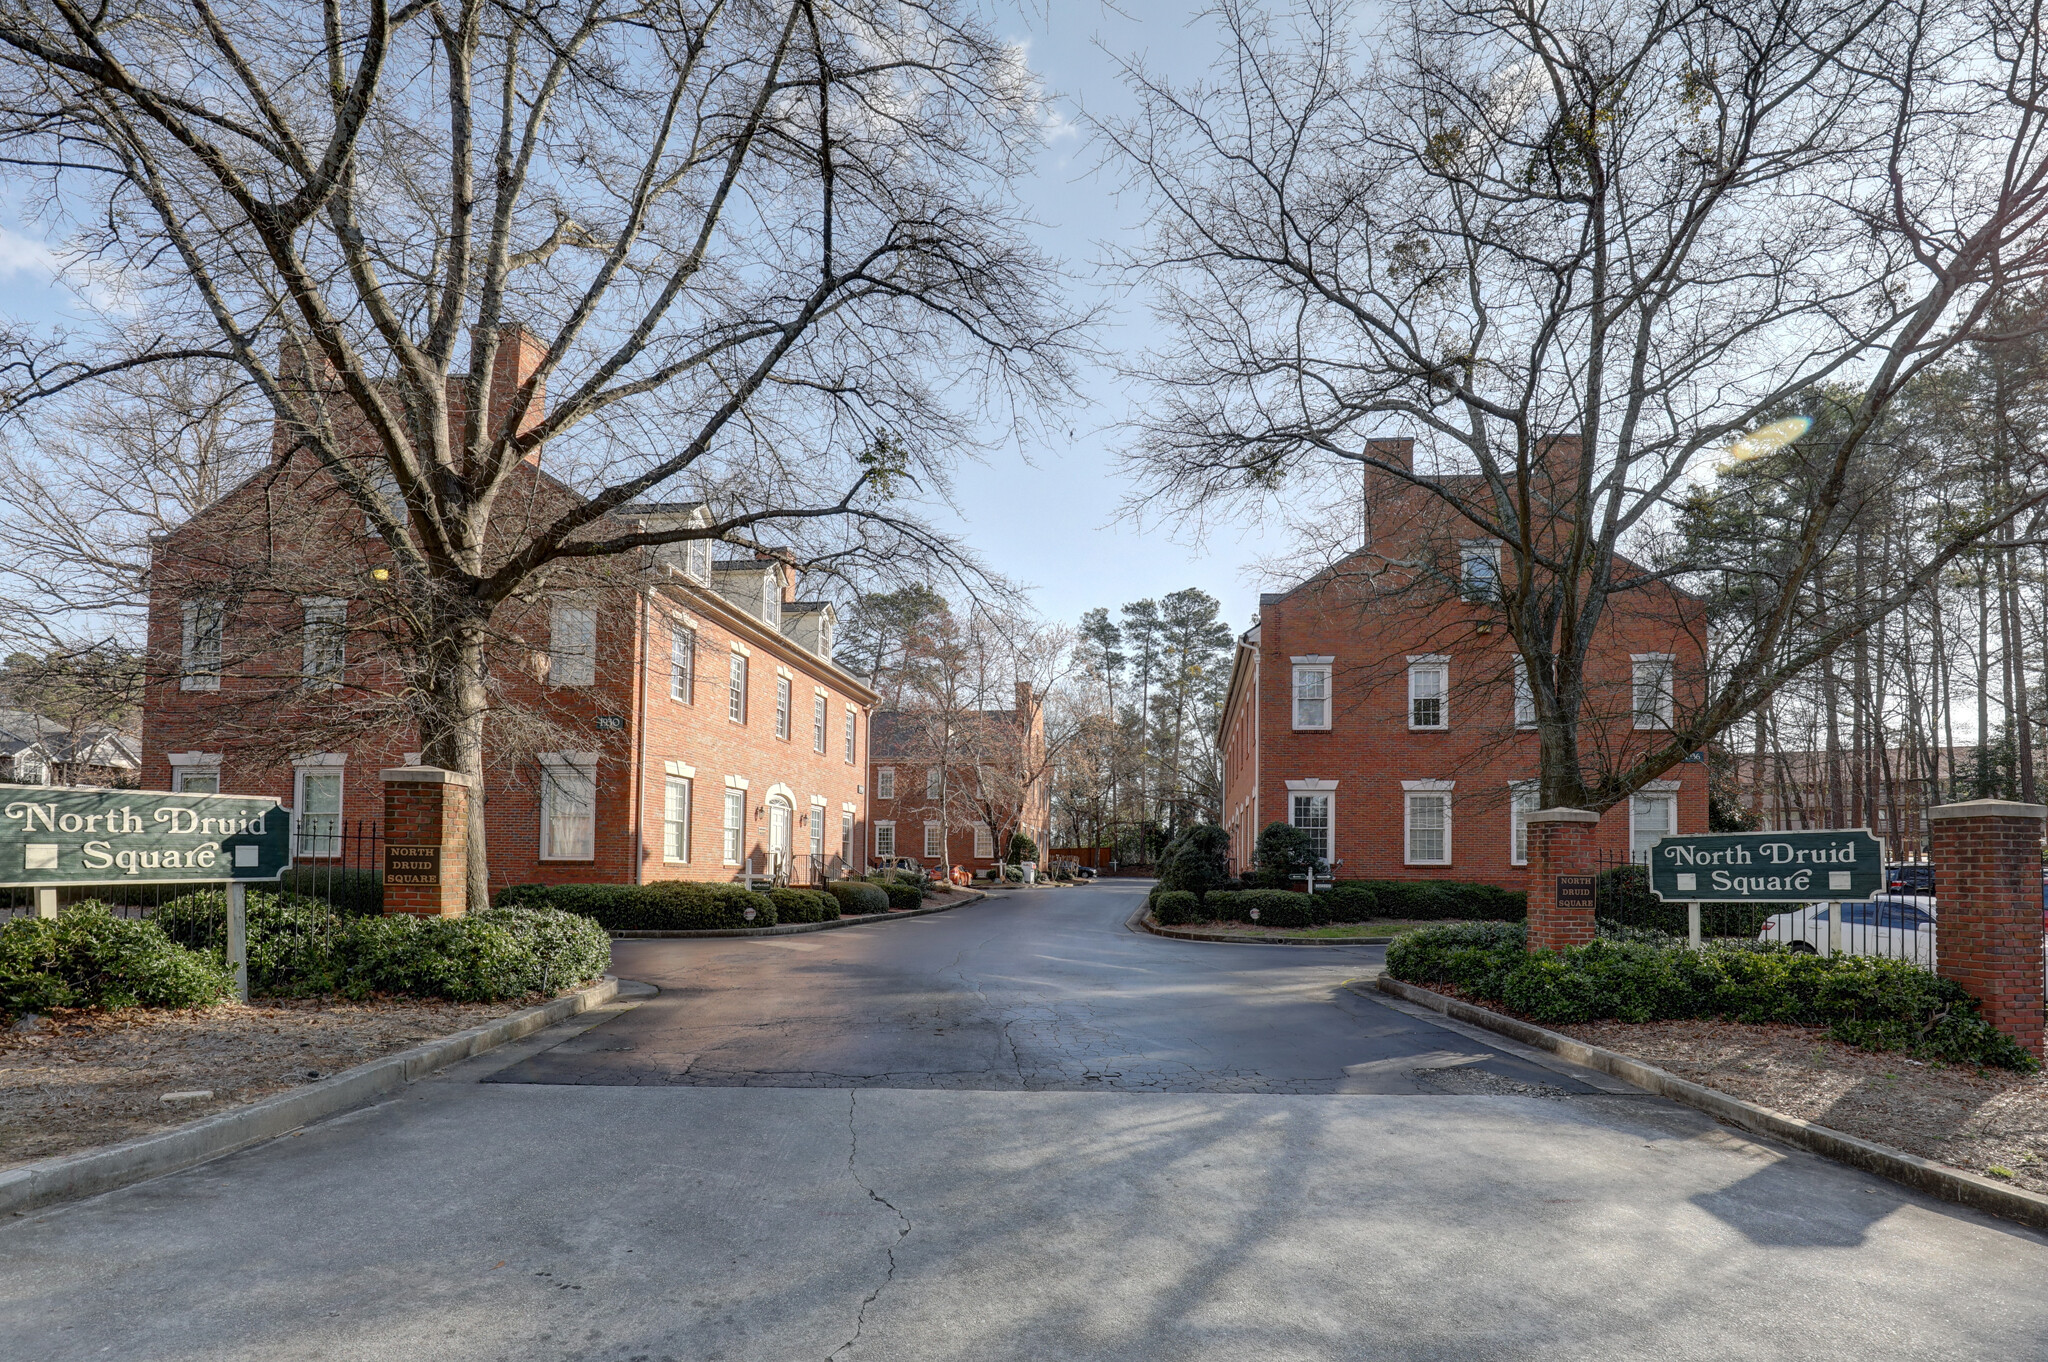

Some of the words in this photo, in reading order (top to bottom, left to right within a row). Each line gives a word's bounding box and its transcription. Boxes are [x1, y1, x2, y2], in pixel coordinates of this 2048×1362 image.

[4, 801, 144, 833] North
[153, 807, 268, 835] Druid
[390, 847, 434, 857] NORTH
[1664, 843, 1752, 866] North
[1759, 841, 1857, 864] Druid
[82, 840, 219, 875] Square
[392, 861, 432, 870] DRUID
[387, 874, 437, 884] SQUARE
[1560, 877, 1592, 885] NORTH
[1711, 868, 1813, 895] Square
[1562, 888, 1590, 896] DRUID
[1558, 899, 1594, 908] SQUARE
